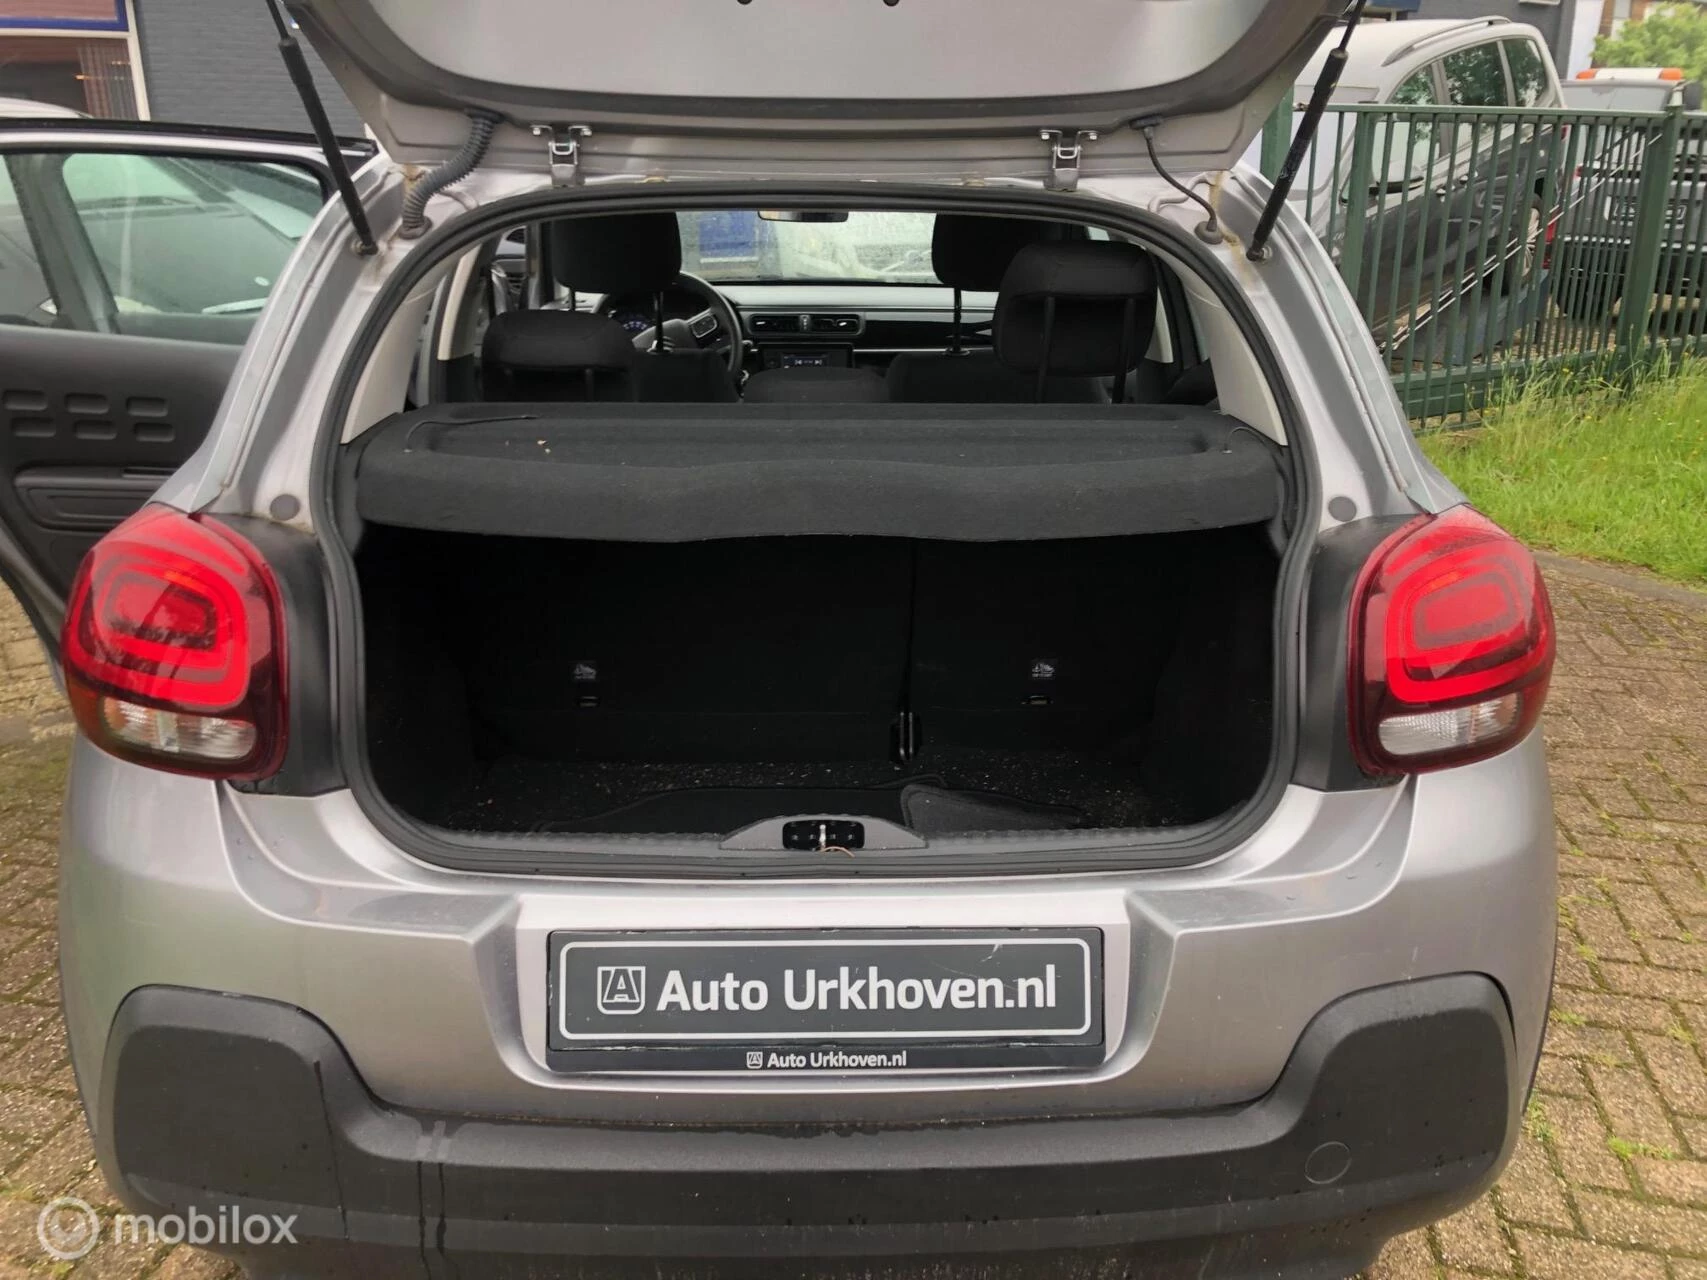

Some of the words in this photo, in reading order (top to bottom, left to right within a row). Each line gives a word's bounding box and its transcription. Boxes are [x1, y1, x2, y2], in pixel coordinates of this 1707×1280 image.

[656, 970, 769, 1011] Auto
[784, 964, 1056, 1010] Urkhoven.nl
[767, 1052, 807, 1068] Auto
[810, 1050, 907, 1068] Urkhoven.nl
